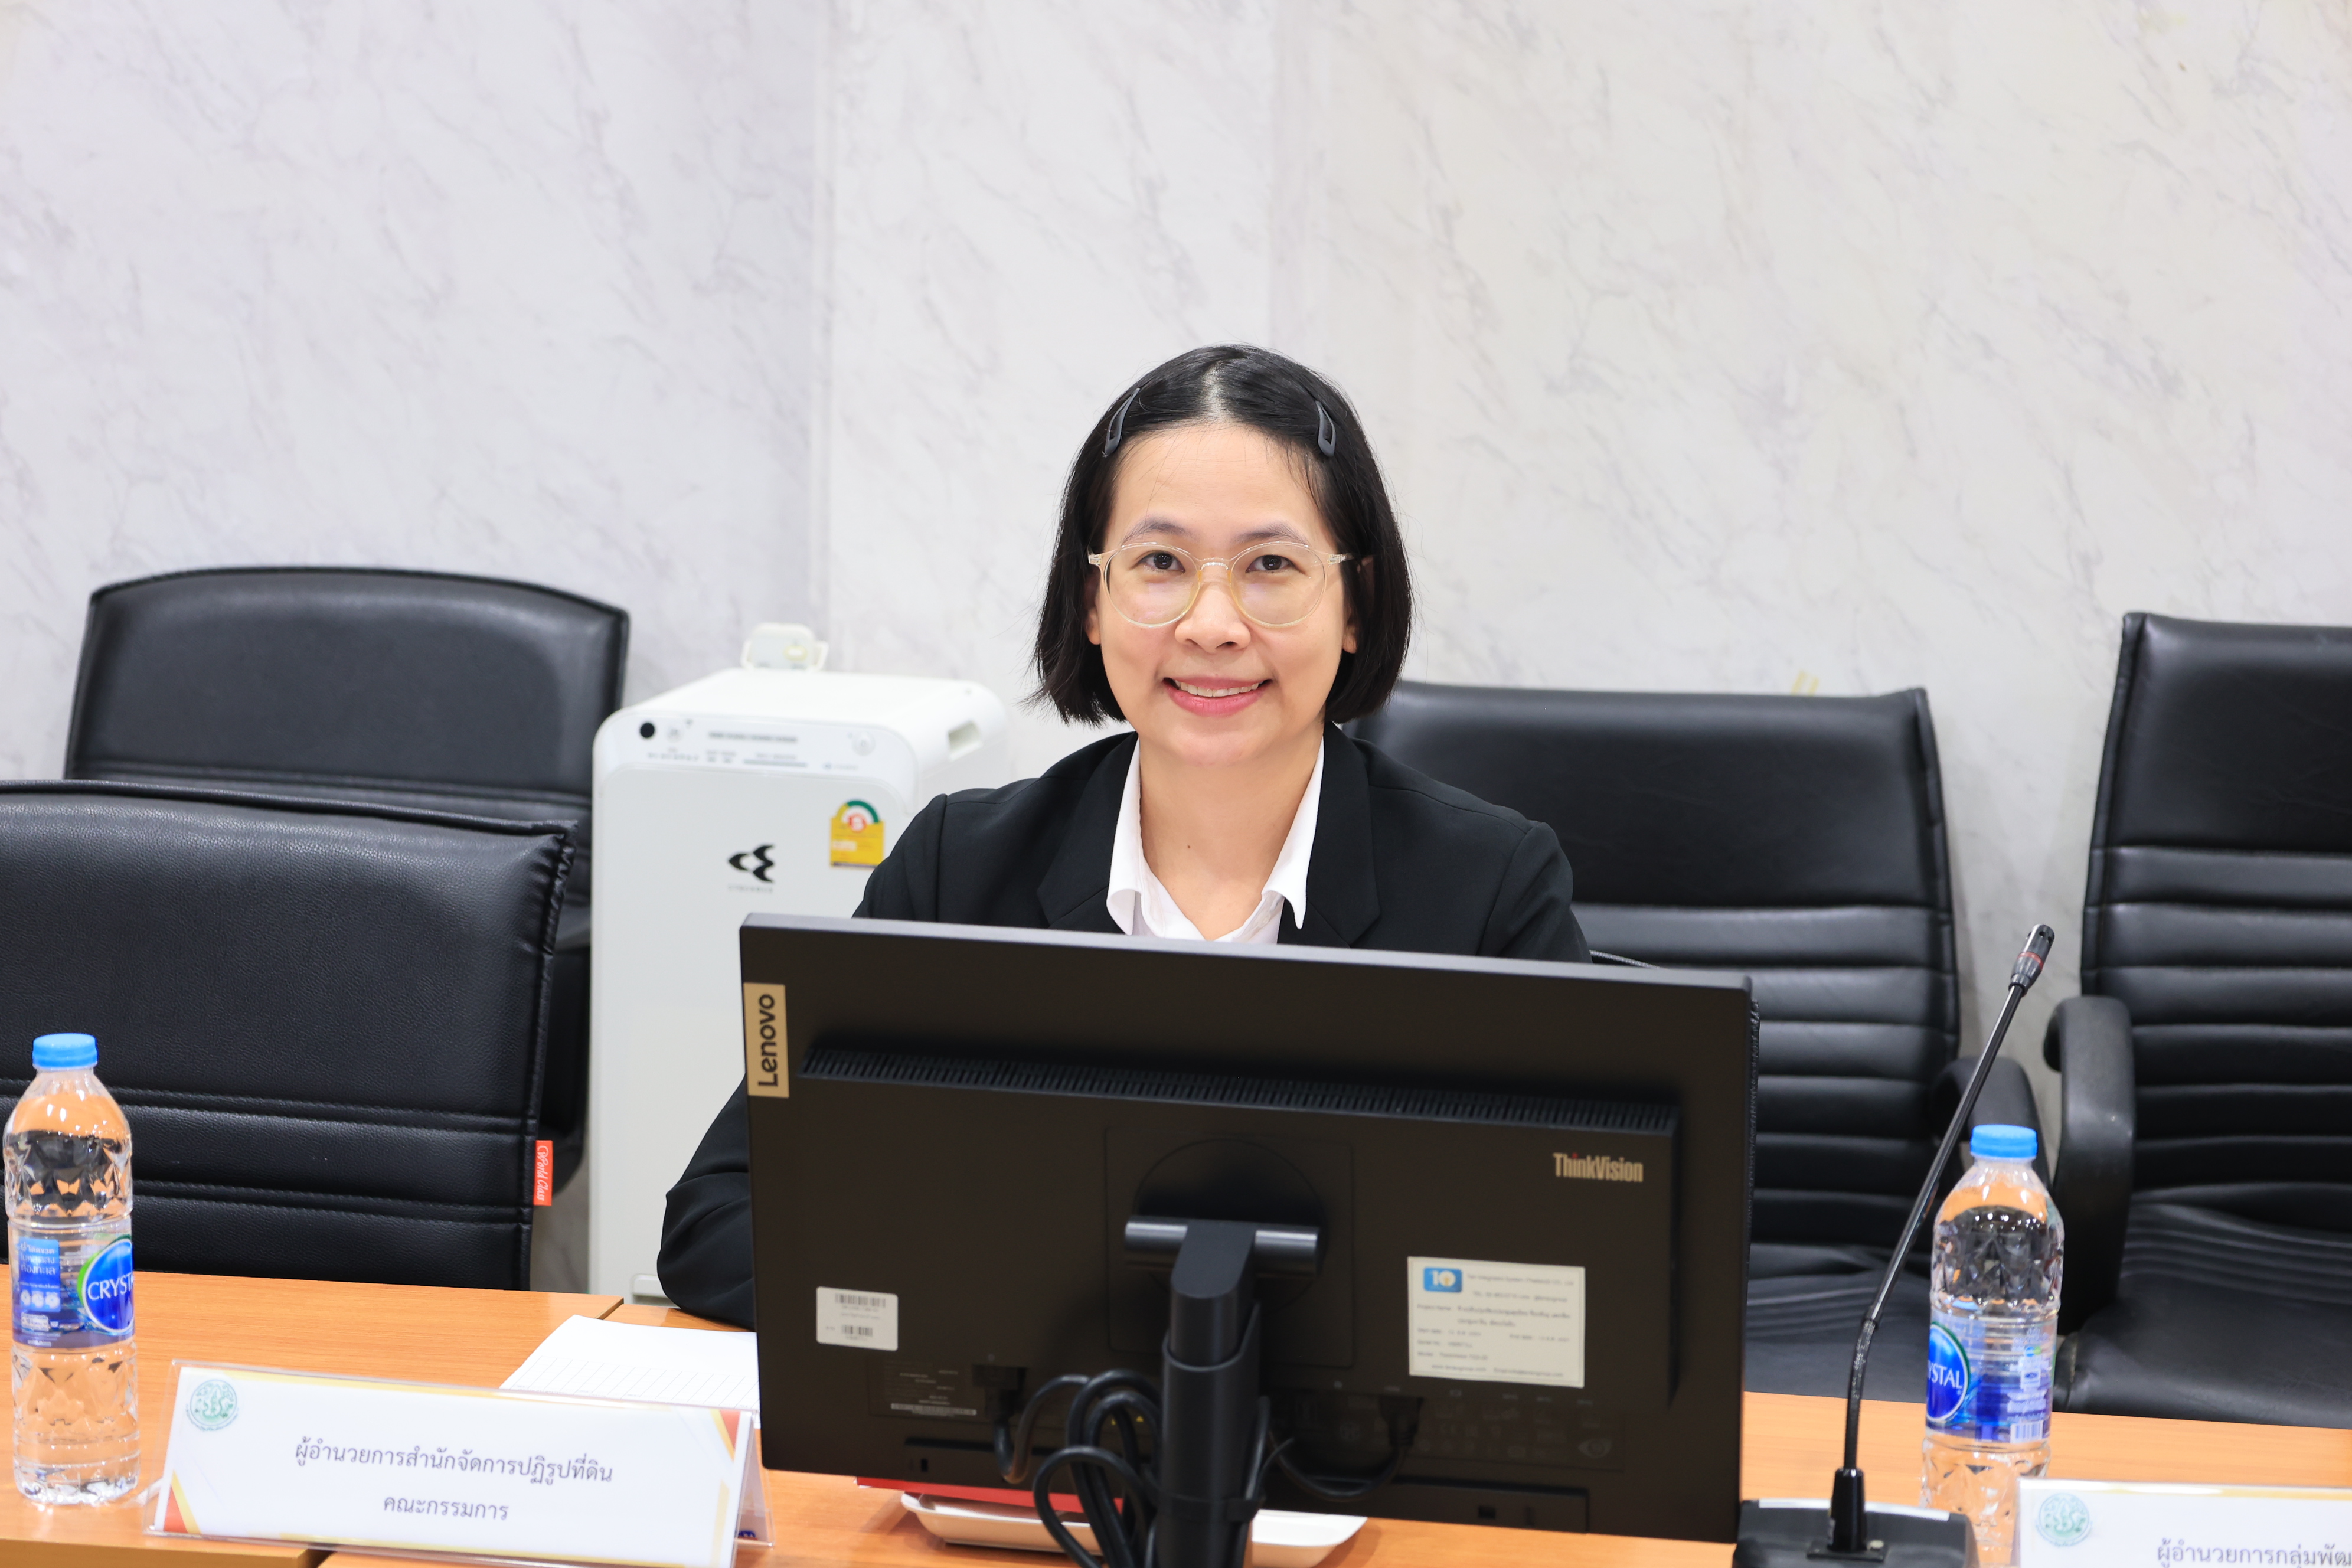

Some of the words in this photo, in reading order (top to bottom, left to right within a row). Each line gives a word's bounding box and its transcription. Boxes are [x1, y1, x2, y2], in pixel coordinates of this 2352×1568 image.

[757, 994, 778, 1087] Lenovo
[537, 1145, 549, 1179] World
[1553, 1152, 1644, 1182] ThinkVision
[536, 1179, 548, 1201] Class
[295, 1436, 612, 1485] ผู้อำนวยการสำนักจัดการปฏิรูปที่ดิน
[384, 1495, 509, 1521] คณะกรรมการ
